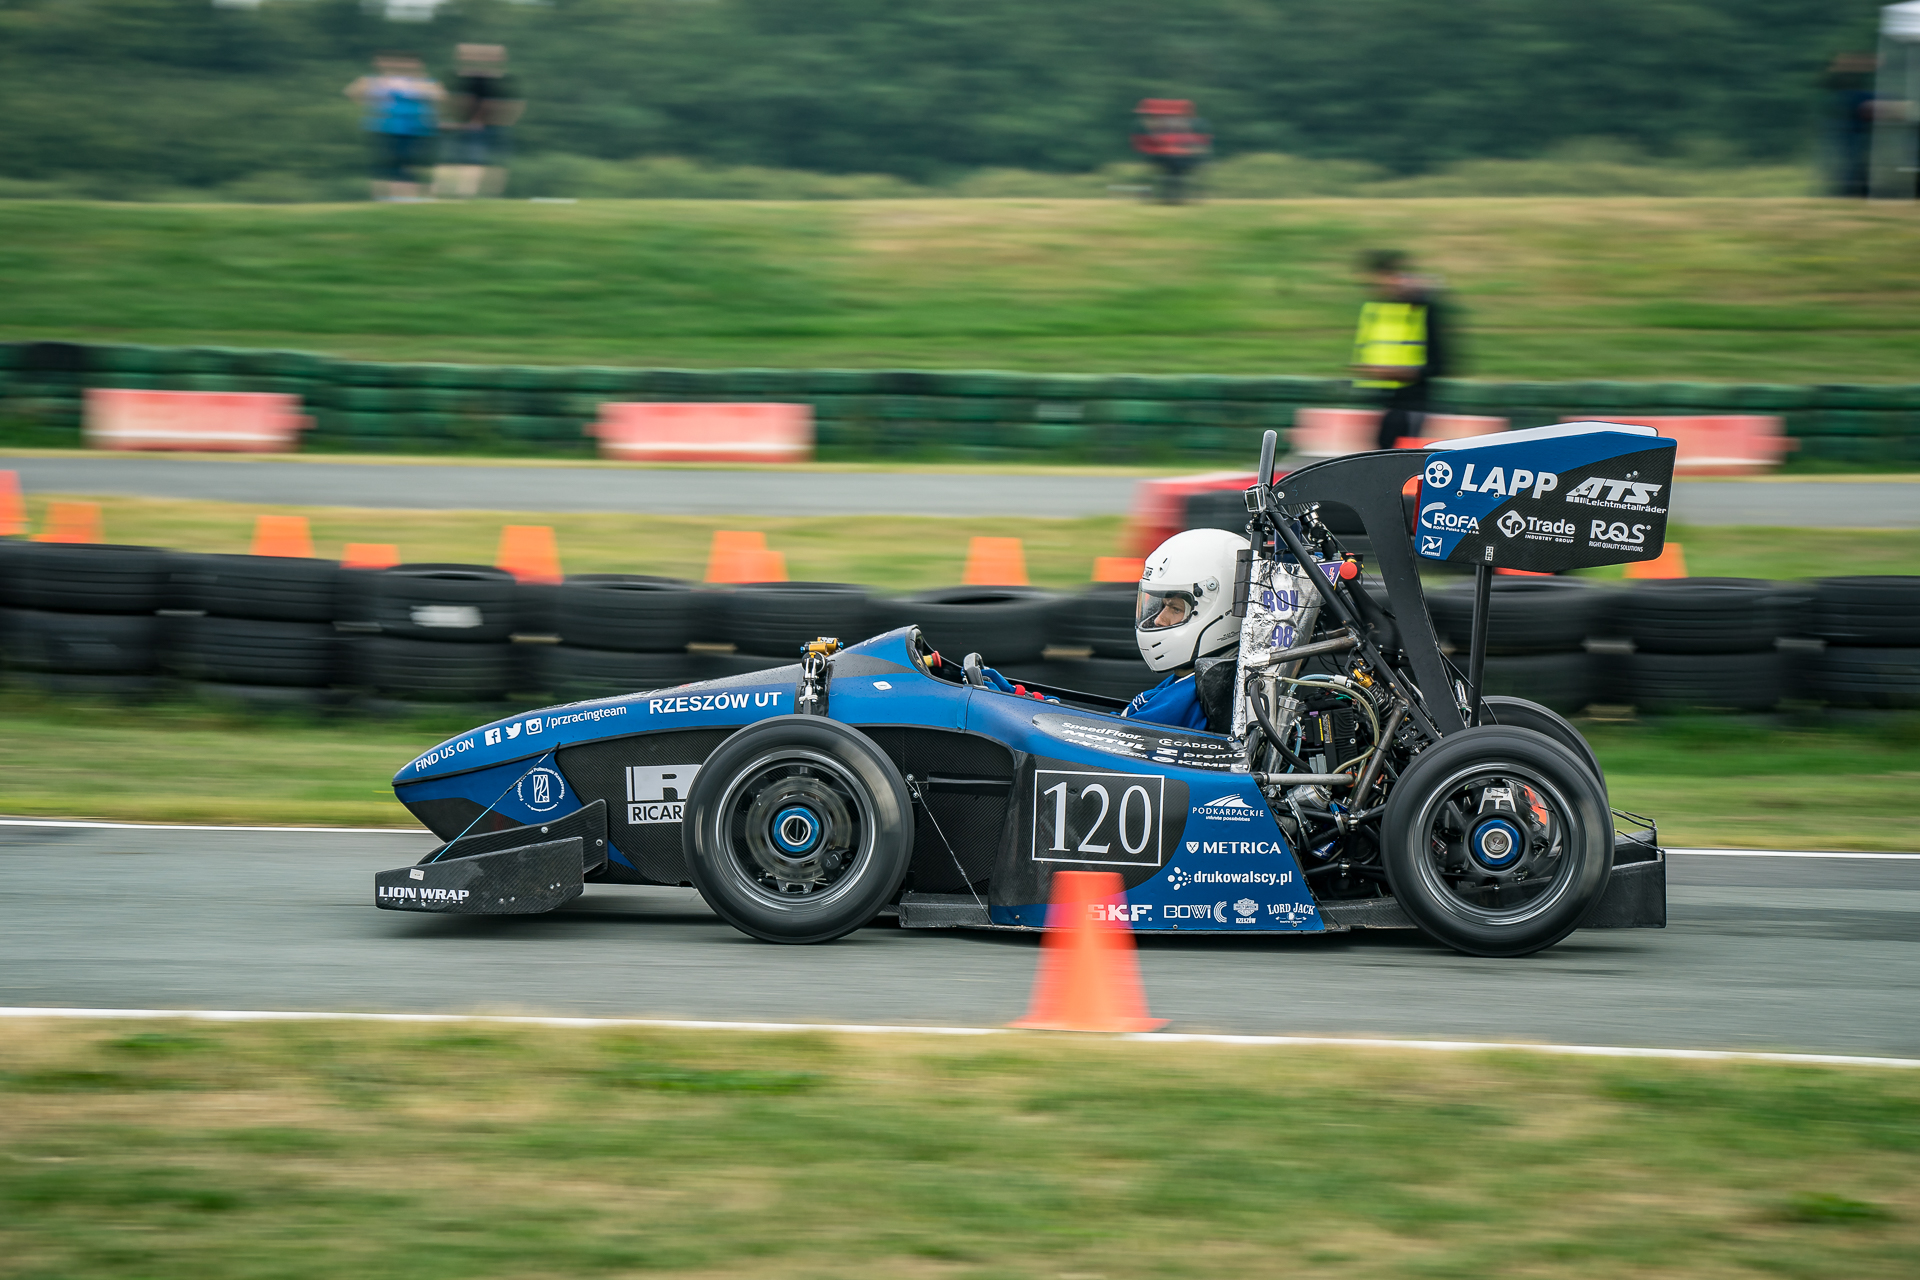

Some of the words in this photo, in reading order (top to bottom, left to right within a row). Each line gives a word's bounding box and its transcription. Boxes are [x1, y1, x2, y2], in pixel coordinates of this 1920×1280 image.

[1460, 463, 1559, 499] LAPP
[1565, 476, 1663, 505] ATS
[1586, 498, 1667, 514] Leichtmetallräder
[1433, 512, 1480, 530] ROFA
[1526, 516, 1576, 535] Trade
[1524, 534, 1553, 542] INDUSTRY
[1588, 540, 1602, 548] RIGHT
[1602, 542, 1620, 550] QUALITY
[1620, 544, 1644, 553] SOLUTIONS
[1271, 625, 1293, 648] 98
[649, 692, 750, 715] RZESZÓW
[755, 692, 782, 707] UT
[415, 752, 439, 772] FIND
[440, 745, 456, 759] US
[456, 737, 475, 753] ON
[546, 706, 627, 729] /przracingteam
[1061, 729, 1147, 751] MOTUL
[1173, 741, 1225, 750] CADSOL
[632, 804, 686, 822] RICAR
[1043, 781, 1152, 855] 120
[1192, 806, 1265, 817] PODKARPACKIE
[1203, 841, 1282, 854] METRICA
[1193, 870, 1292, 886] drukowalscy.pl
[379, 886, 417, 898] LION
[419, 888, 470, 901] WRAP
[1266, 903, 1292, 916] LORD
[1292, 902, 1316, 916] JACK
